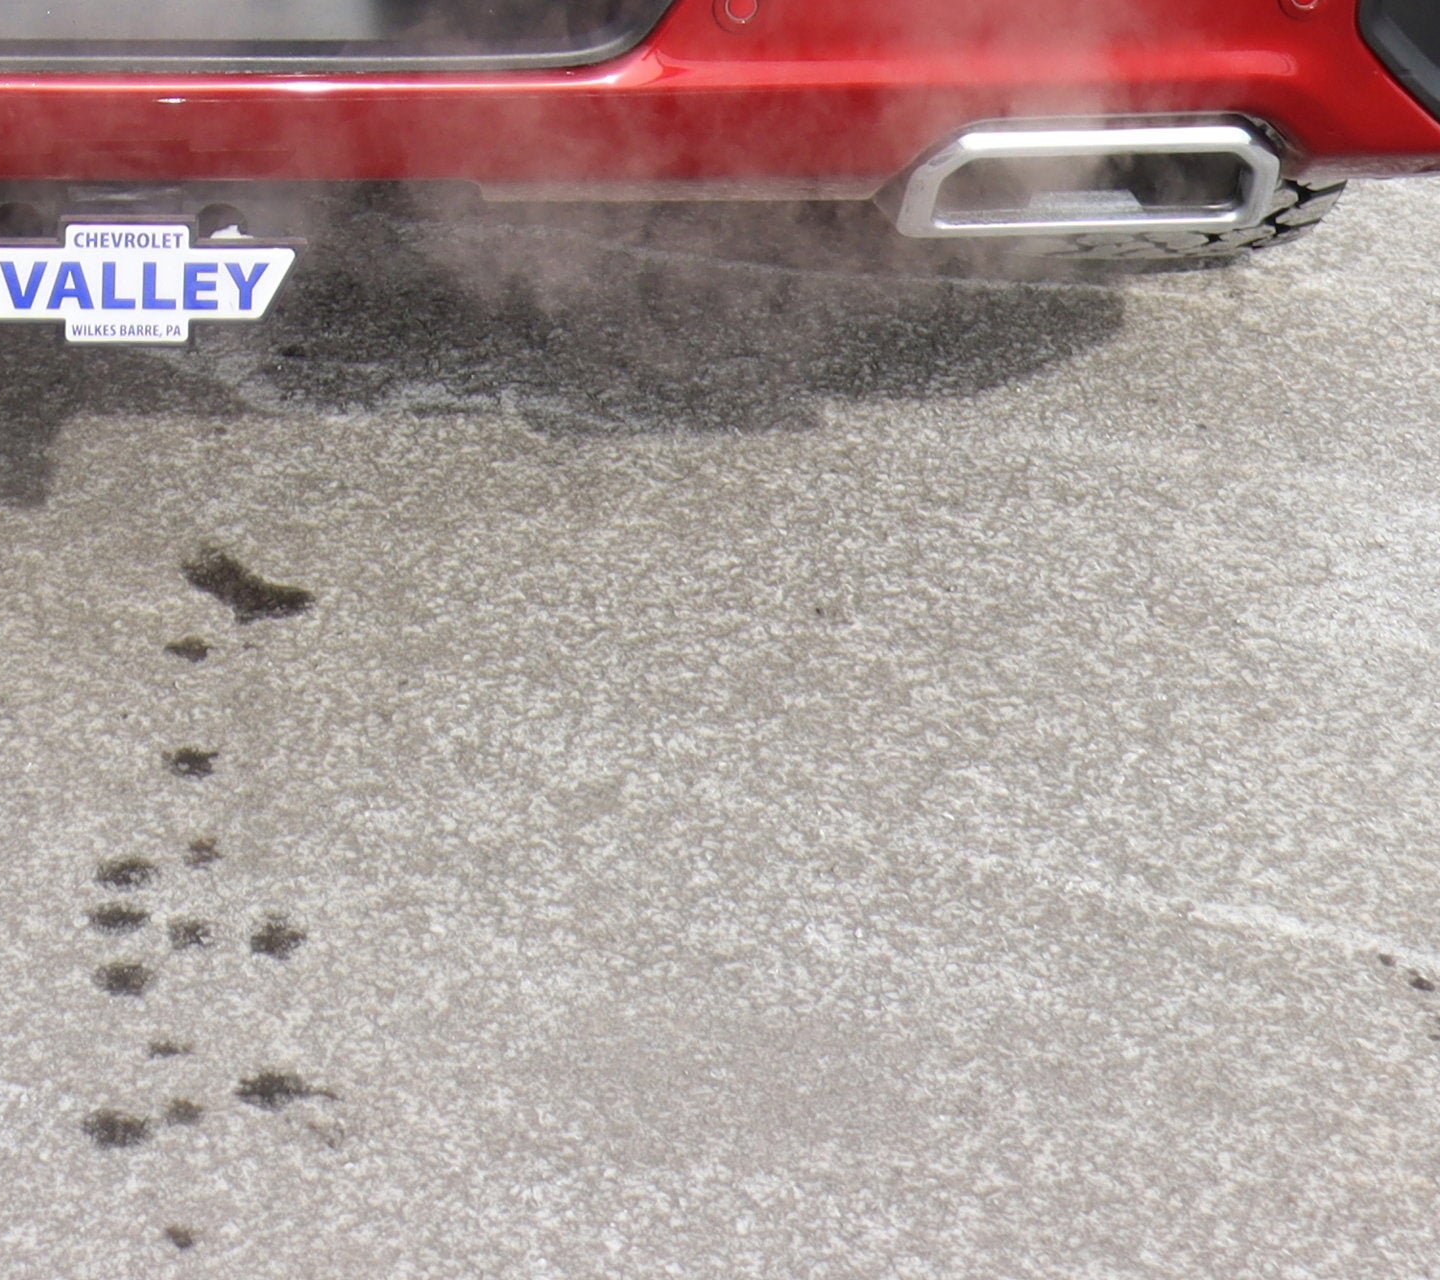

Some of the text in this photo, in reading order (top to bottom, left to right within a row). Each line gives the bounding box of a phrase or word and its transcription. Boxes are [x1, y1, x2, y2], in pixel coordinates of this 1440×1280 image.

[73, 232, 184, 249] CHEVROLET
[0, 261, 270, 311] VALLEY
[71, 324, 182, 339] WILKES BARRE, PA
